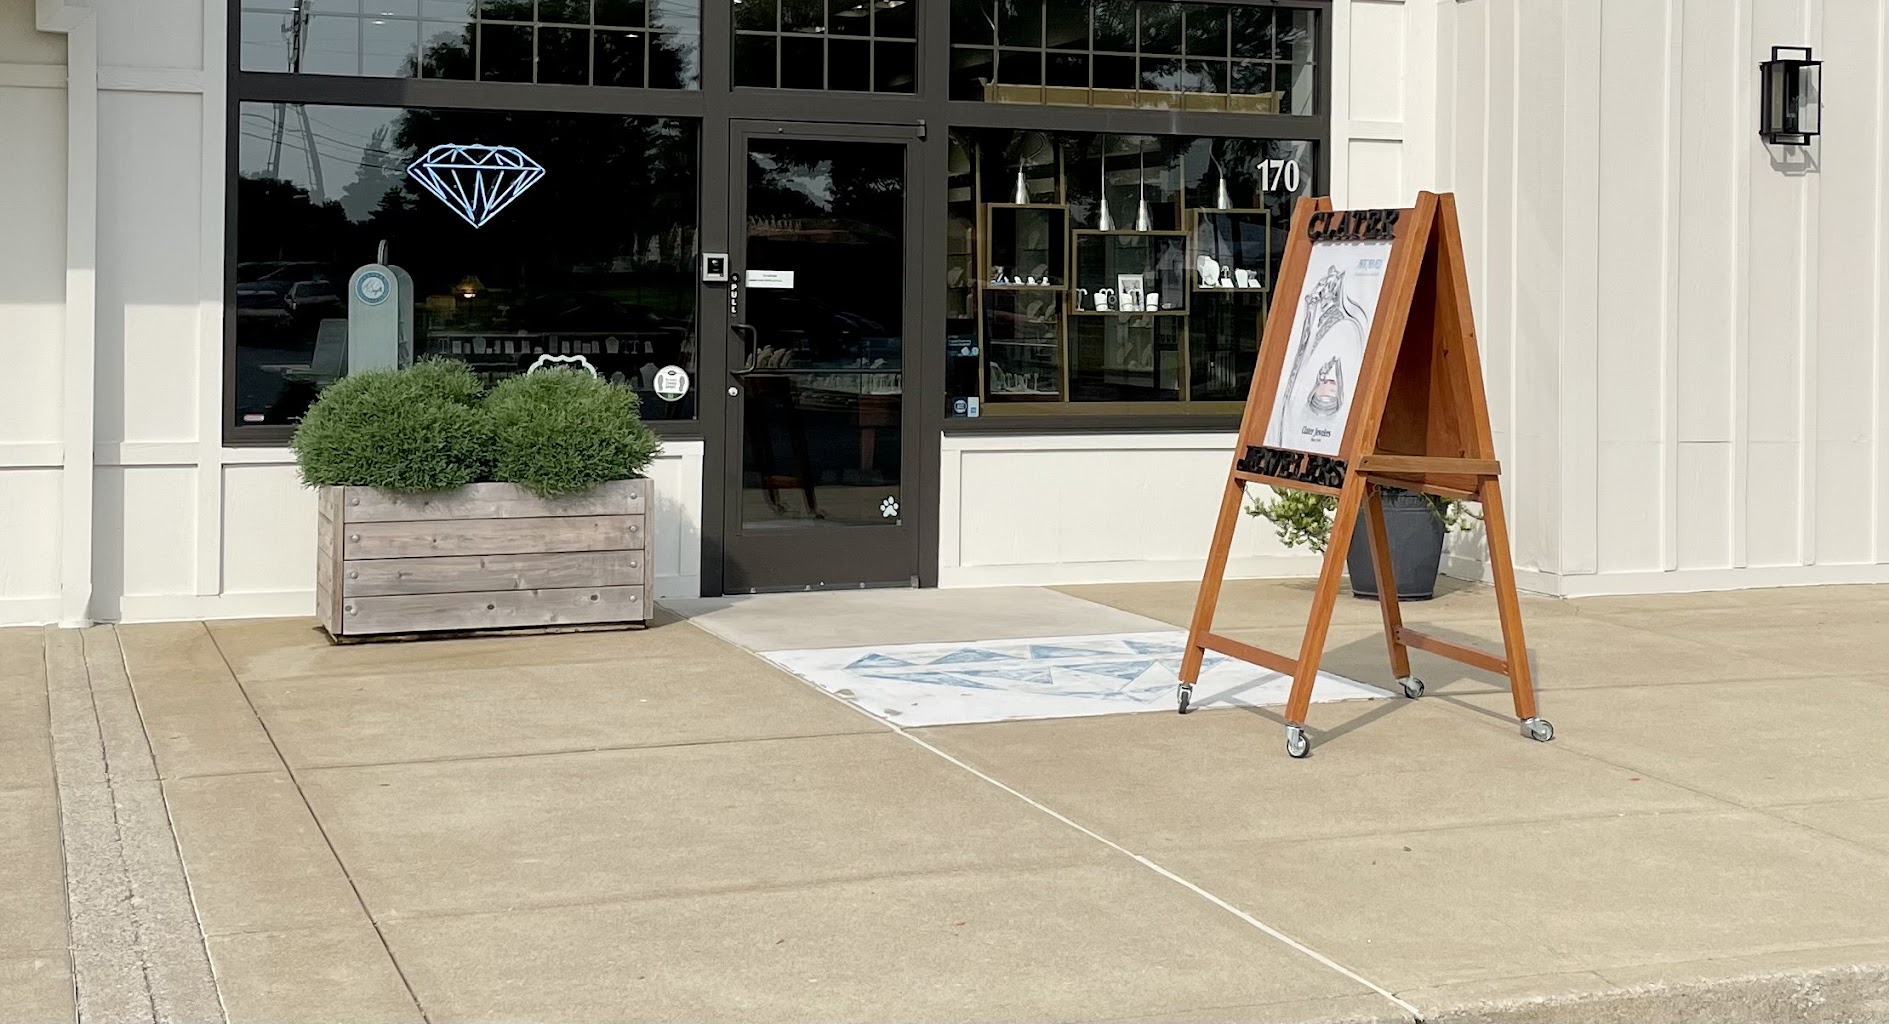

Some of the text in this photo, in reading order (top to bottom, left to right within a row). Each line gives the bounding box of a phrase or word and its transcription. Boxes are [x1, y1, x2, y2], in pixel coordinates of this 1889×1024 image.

[1256, 158, 1300, 192] 170
[1307, 209, 1399, 242] CLATER
[730, 283, 738, 314] PULL
